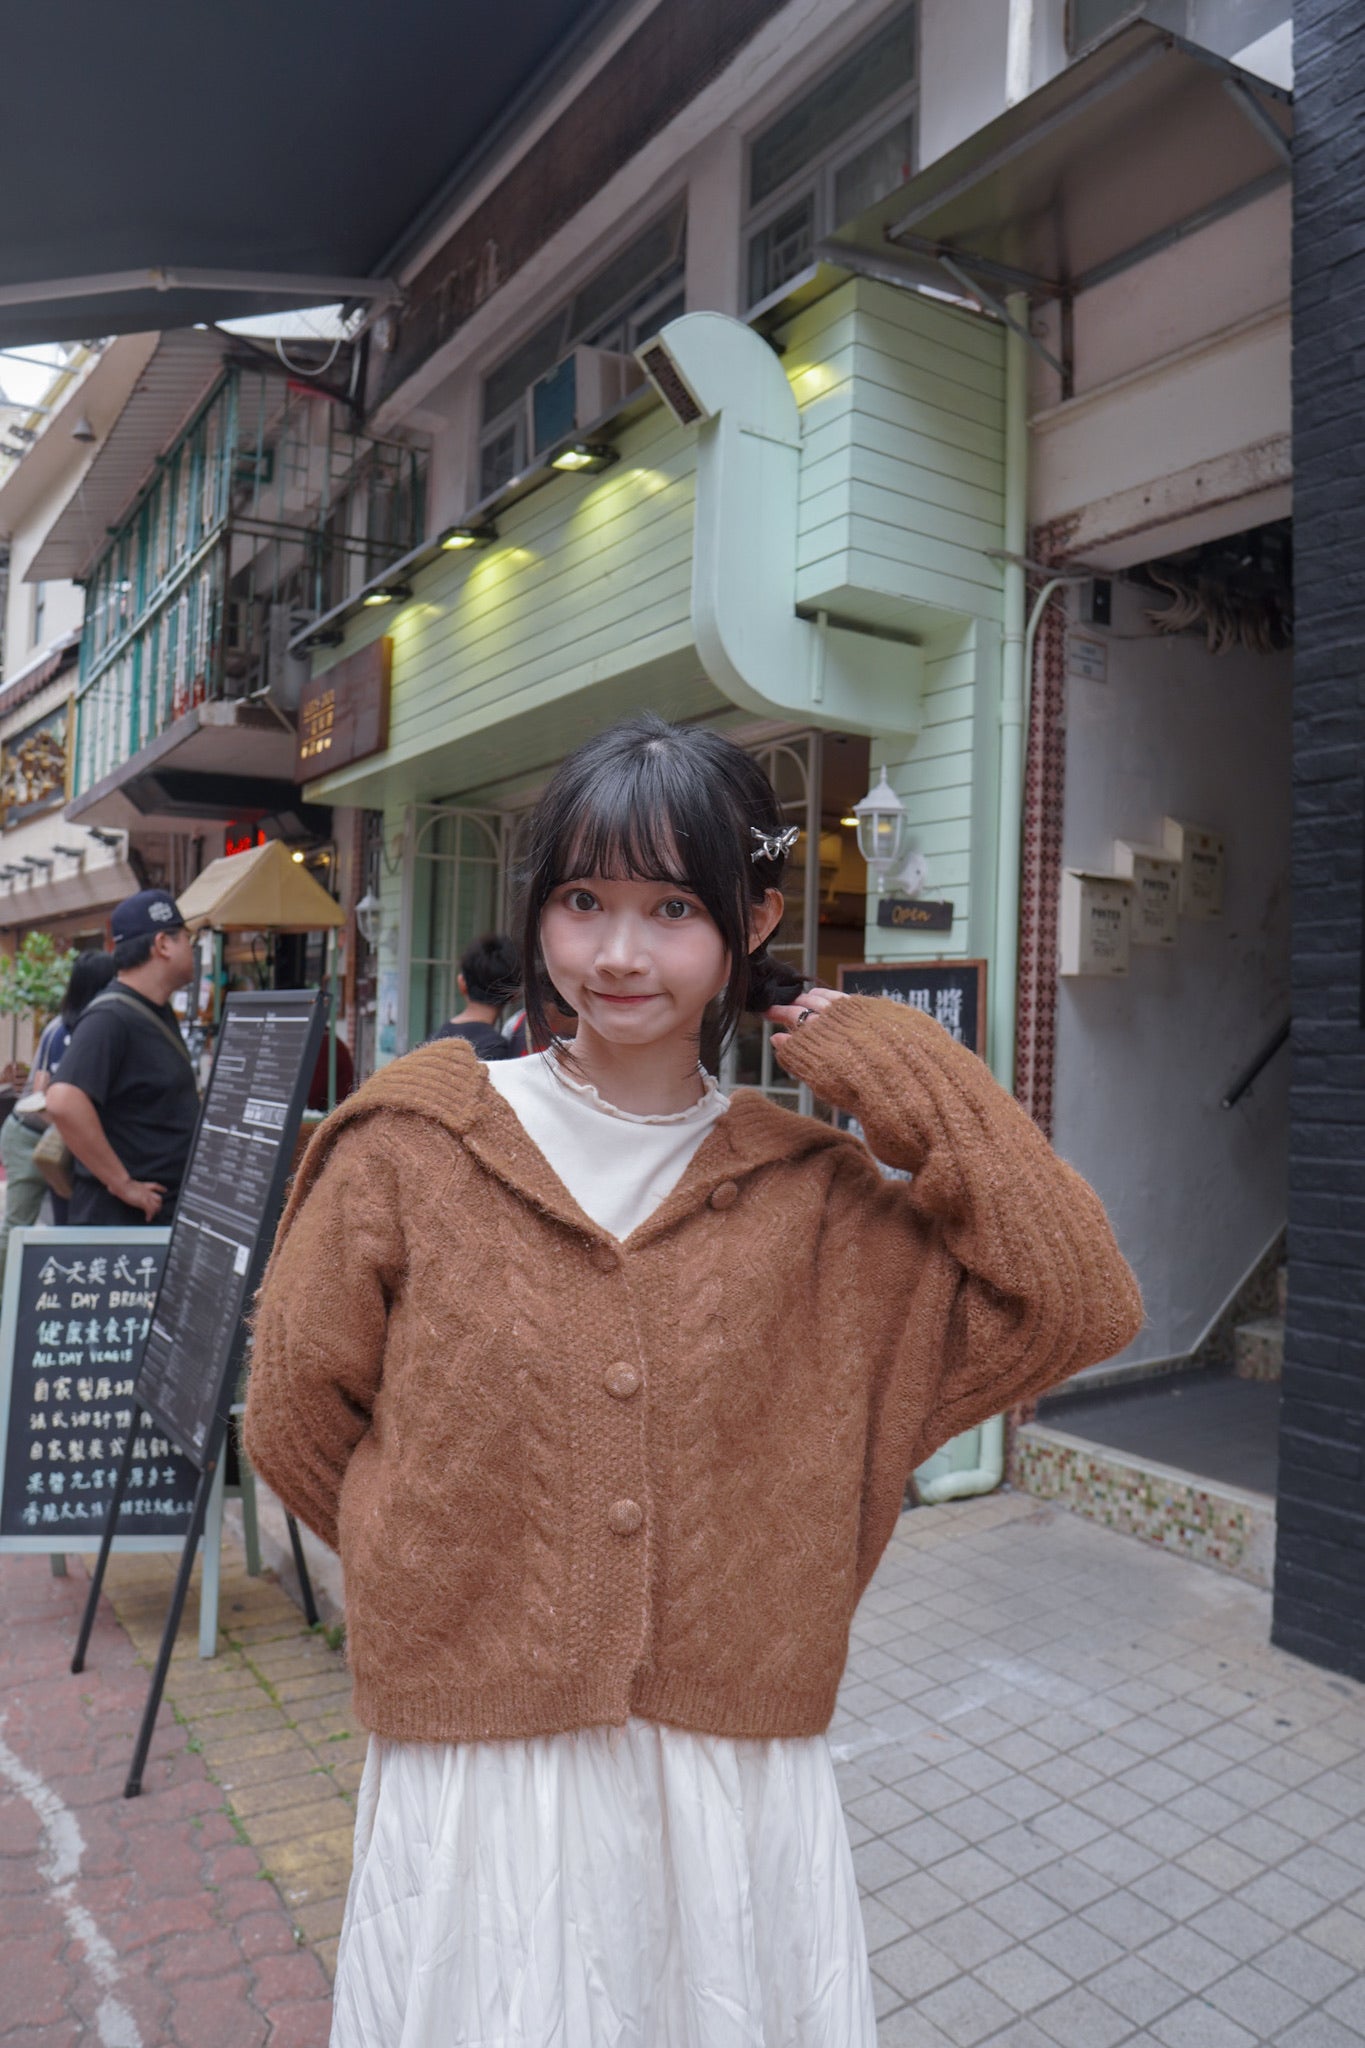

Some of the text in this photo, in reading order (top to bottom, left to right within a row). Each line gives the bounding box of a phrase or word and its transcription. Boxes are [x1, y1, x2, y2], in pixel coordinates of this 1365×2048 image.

[891, 904, 932, 926] Open
[35, 1291, 61, 1312] ALL
[70, 1291, 100, 1310] DAY
[32, 1350, 57, 1368] ALL
[58, 1351, 84, 1367] DAY
